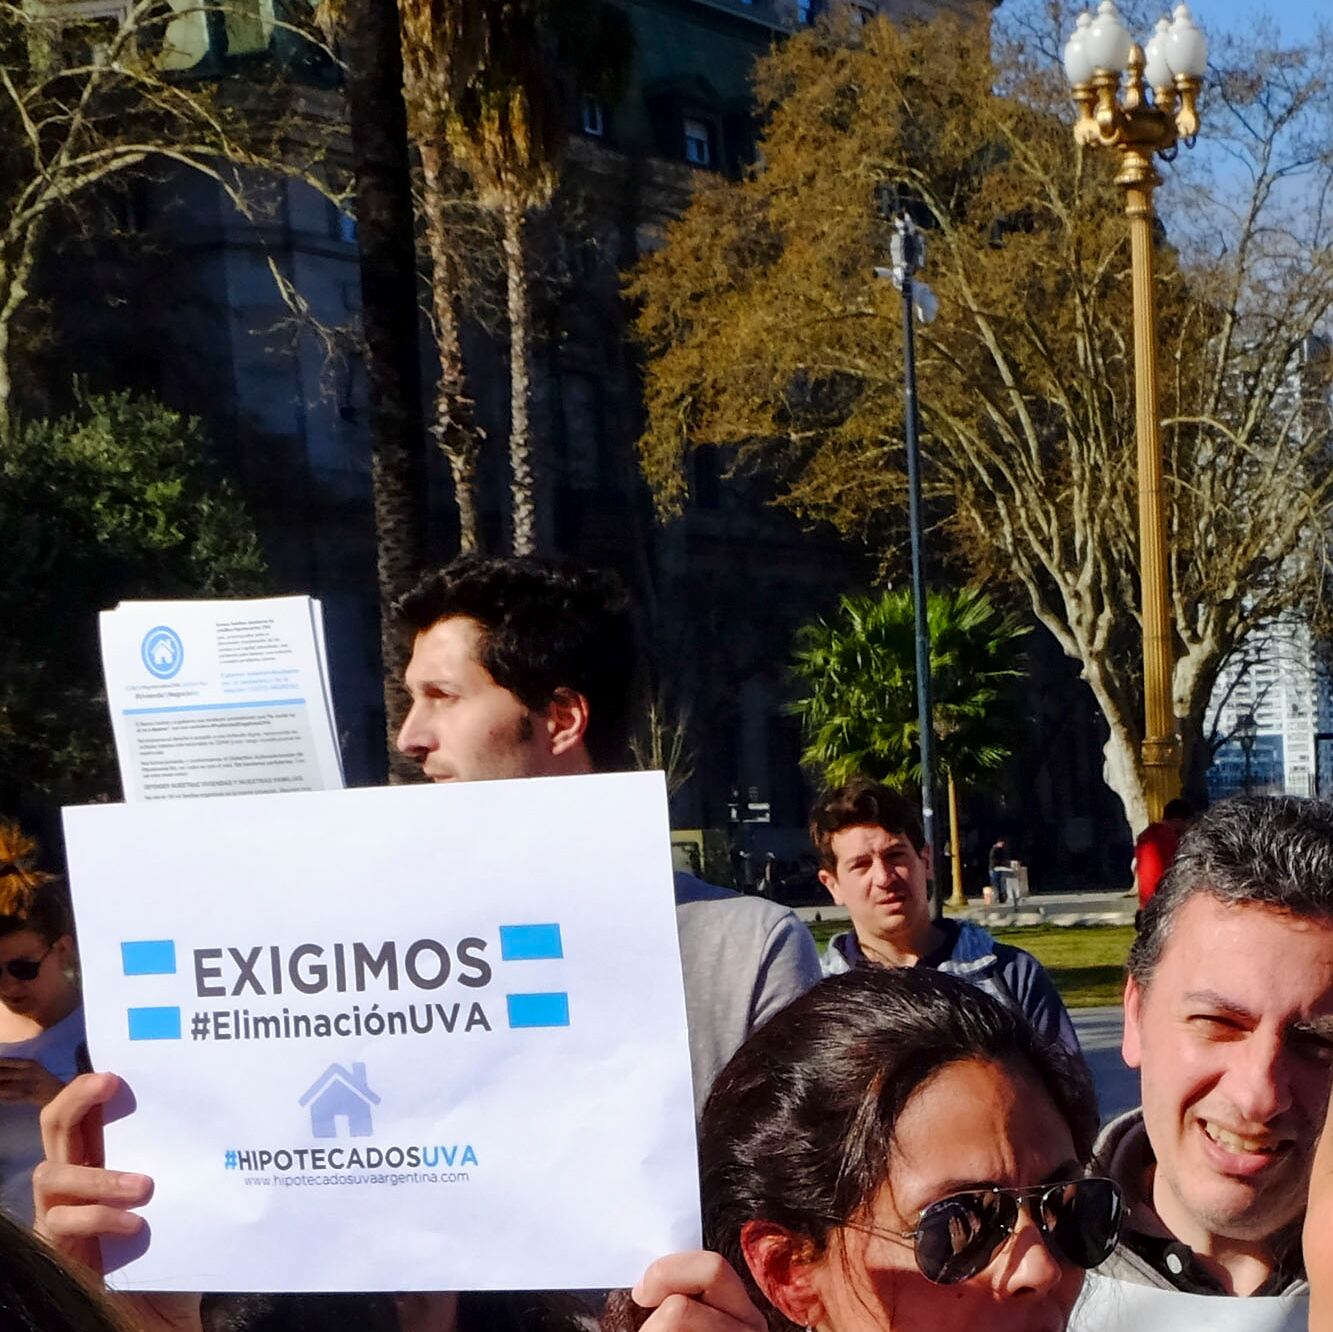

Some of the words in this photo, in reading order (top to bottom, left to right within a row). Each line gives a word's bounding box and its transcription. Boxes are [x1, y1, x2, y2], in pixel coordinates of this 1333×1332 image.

[194, 936, 492, 998] EXIGIMOS
[190, 1002, 492, 1041] #EliminaciónUVA
[224, 1144, 478, 1171] #HIPOTECADOSUVA
[244, 1171, 471, 1187] www.hipotecadosuvaargentina.com
